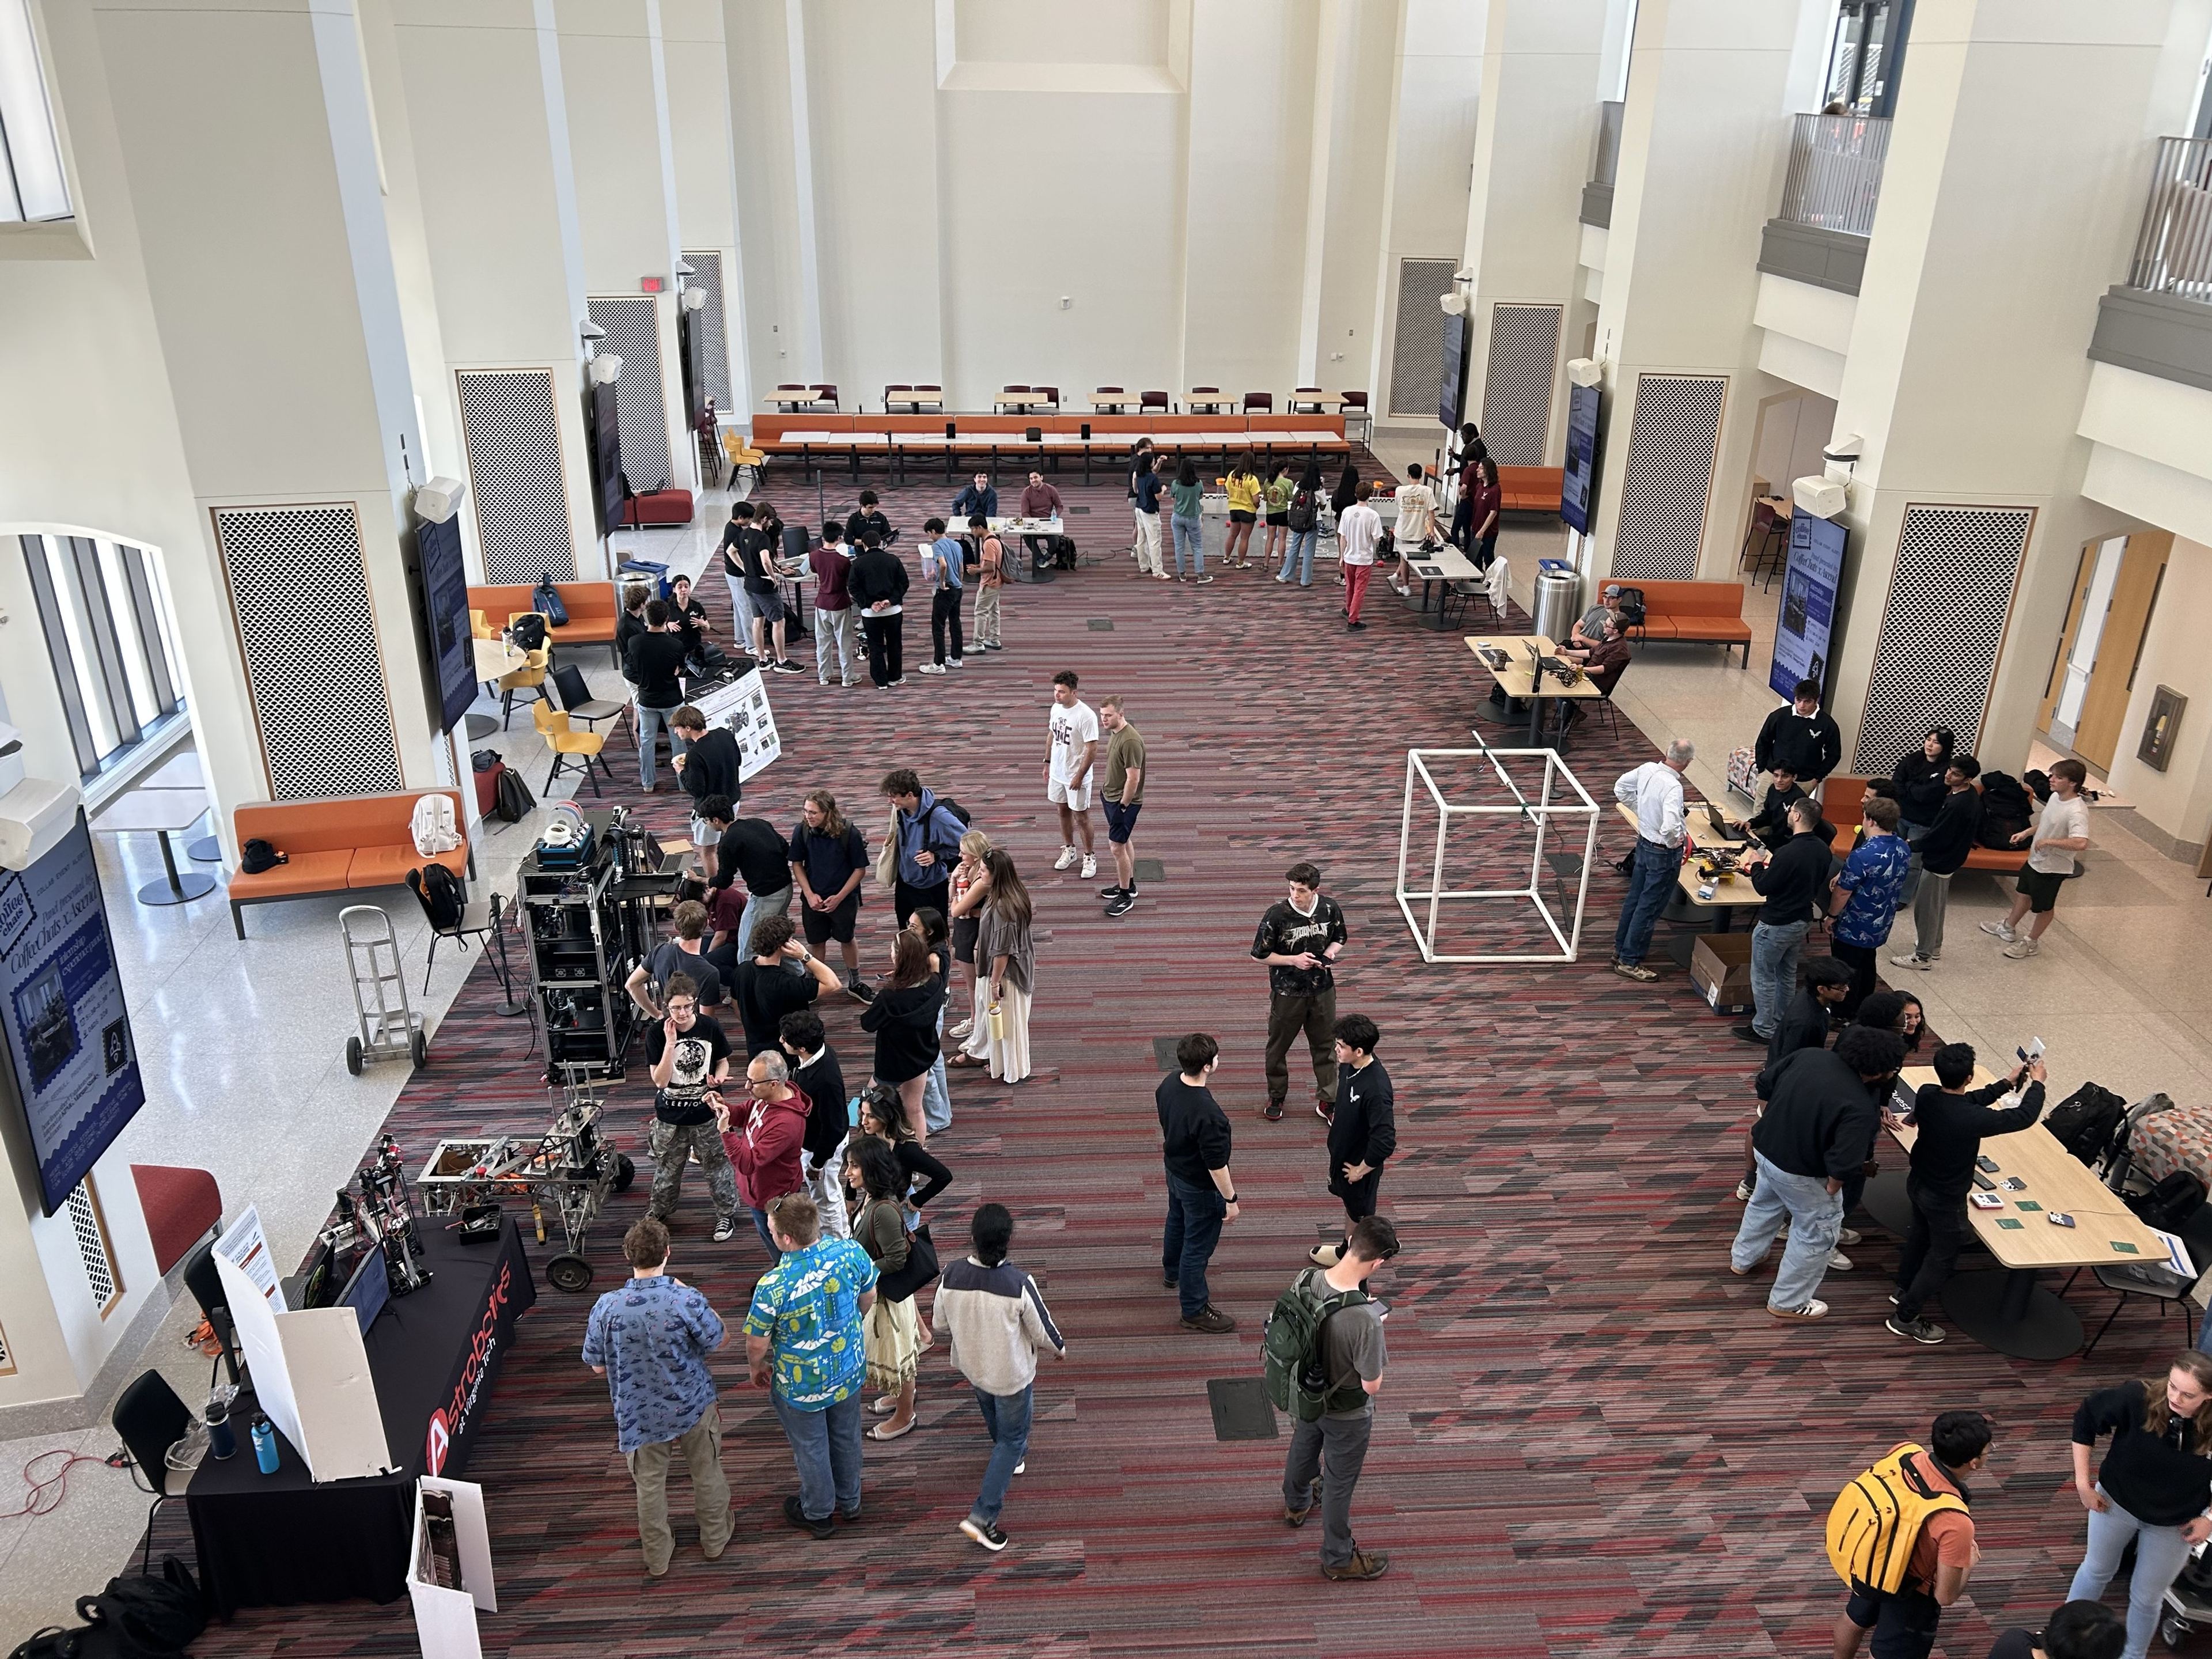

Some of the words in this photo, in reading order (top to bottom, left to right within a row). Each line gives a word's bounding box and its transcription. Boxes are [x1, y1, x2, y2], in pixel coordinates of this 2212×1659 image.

[0, 893, 24, 932] offee
[41, 902, 58, 923] Panel
[59, 879, 84, 909] presented
[69, 883, 97, 918] Ascend
[3, 907, 24, 937] chats
[59, 934, 85, 964] internship
[1892, 1089, 1911, 1111] uest
[459, 1415, 467, 1435] at
[464, 1369, 484, 1416] Virginia
[481, 1336, 496, 1368] Tech
